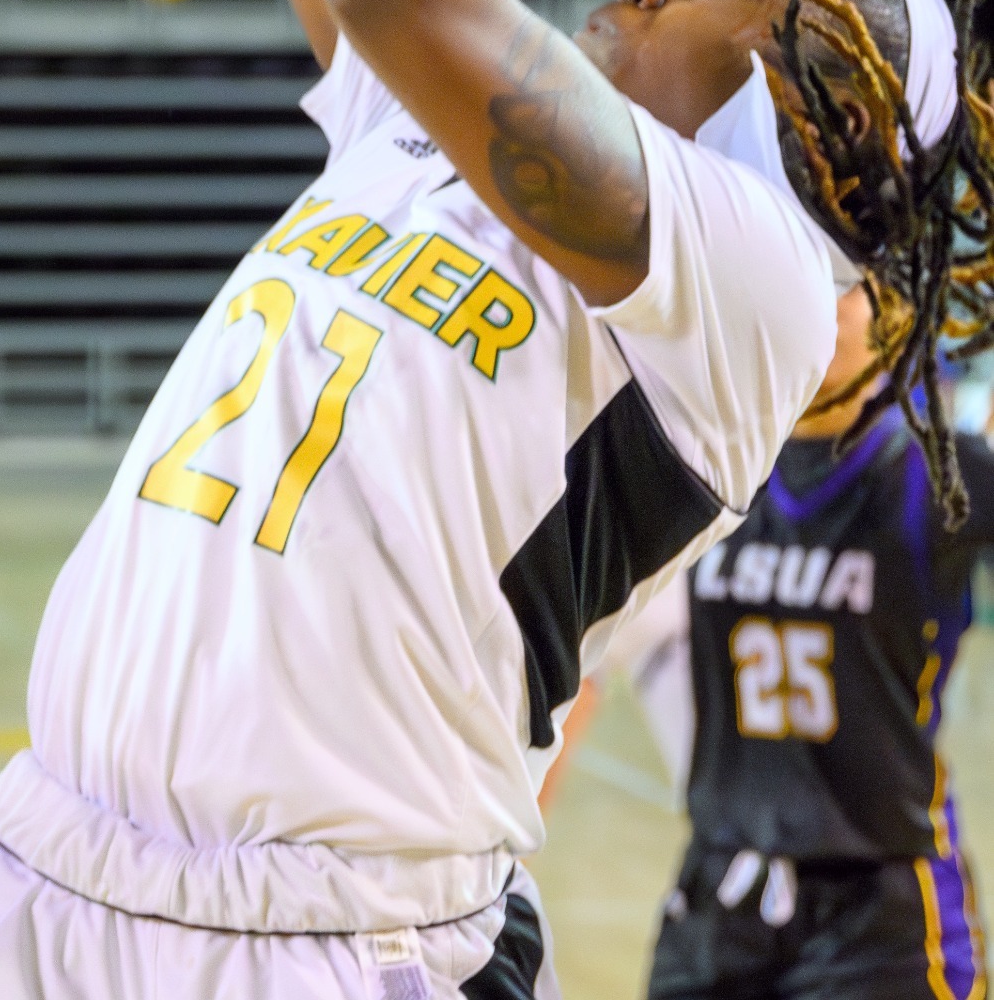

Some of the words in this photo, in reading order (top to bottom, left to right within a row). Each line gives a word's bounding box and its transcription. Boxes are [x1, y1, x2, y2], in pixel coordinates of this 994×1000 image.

[251, 196, 537, 383] XAVIER
[138, 278, 384, 556] 21
[695, 542, 875, 614] LSUA
[729, 615, 839, 742] 25
